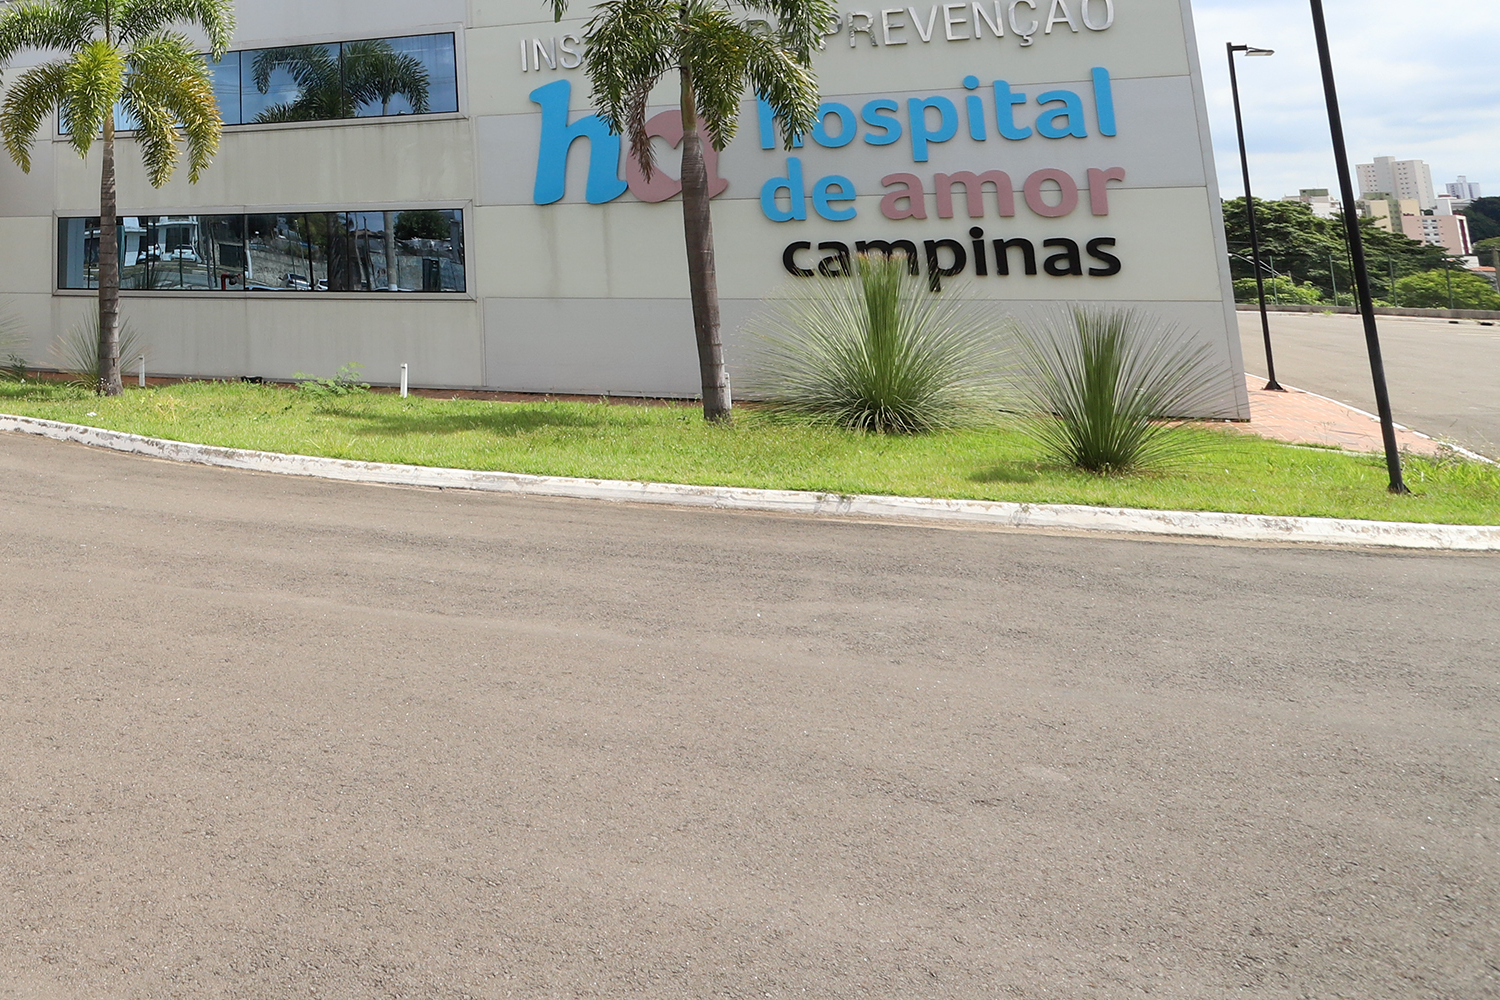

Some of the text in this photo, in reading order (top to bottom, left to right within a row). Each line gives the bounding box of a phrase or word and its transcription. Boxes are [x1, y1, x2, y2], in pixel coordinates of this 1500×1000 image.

[755, 66, 1117, 162] hospital
[760, 157, 1126, 222] de amor
[782, 226, 1122, 292] campinas
